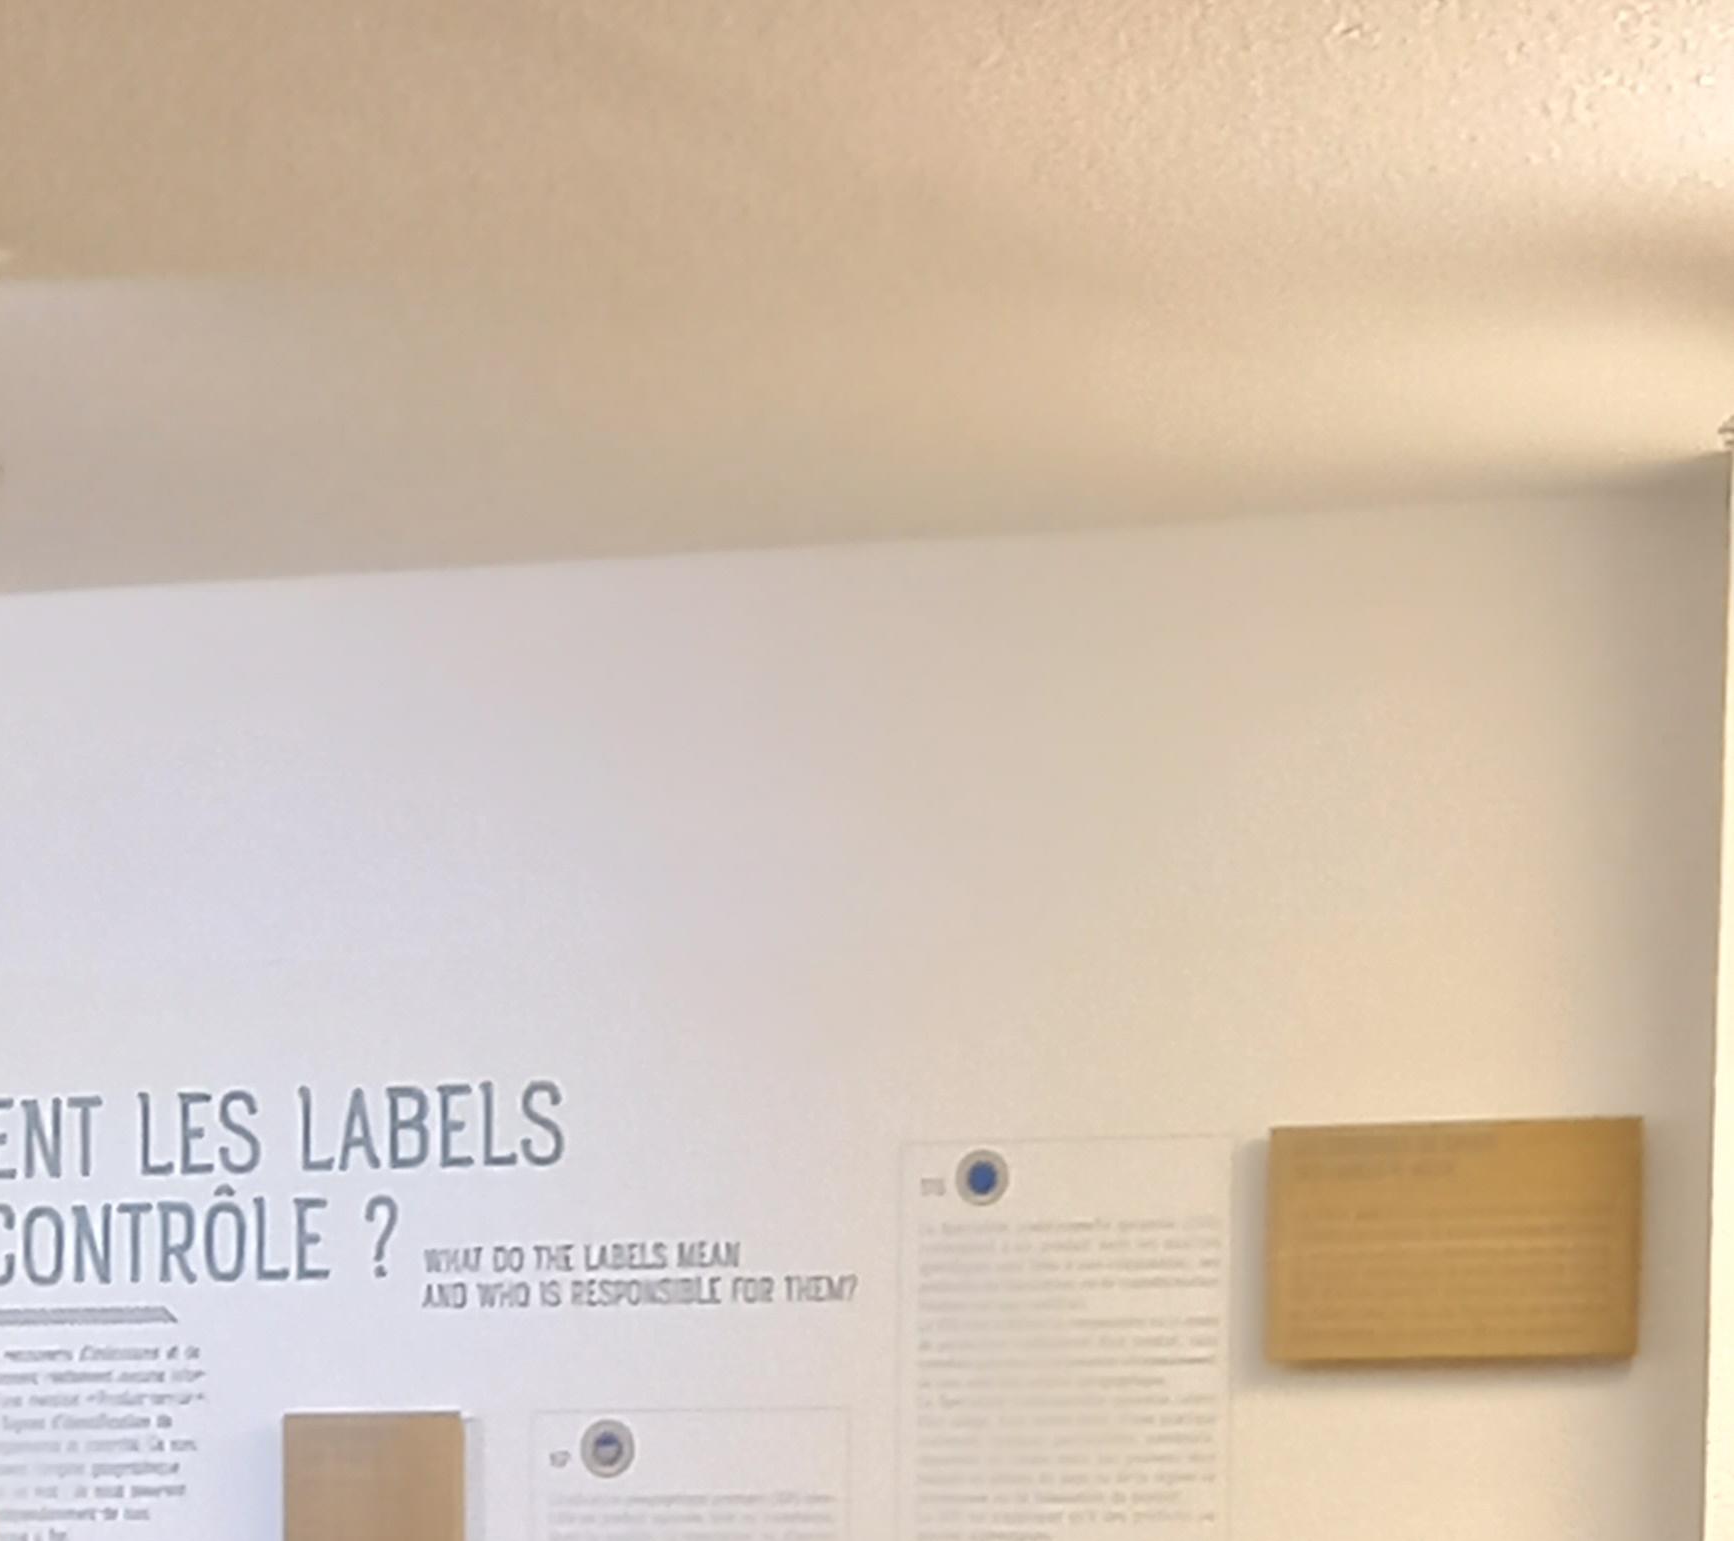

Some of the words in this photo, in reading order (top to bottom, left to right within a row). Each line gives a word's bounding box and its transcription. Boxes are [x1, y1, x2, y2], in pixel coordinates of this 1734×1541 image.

[138, 1090, 261, 1176] LES
[298, 1080, 564, 1171] LABELS
[365, 1194, 398, 1278] ?
[423, 1246, 483, 1273] WHAT
[493, 1246, 524, 1272] DO
[534, 1244, 573, 1272] THE
[584, 1242, 667, 1272] LABELS
[677, 1241, 740, 1269] MEAN
[422, 1282, 466, 1309] AND
[477, 1281, 530, 1308] WHO
[540, 1280, 561, 1307] IS
[572, 1276, 720, 1306] RESPONSIBLE
[732, 1275, 773, 1304] FOR
[785, 1274, 857, 1303] THEM?
